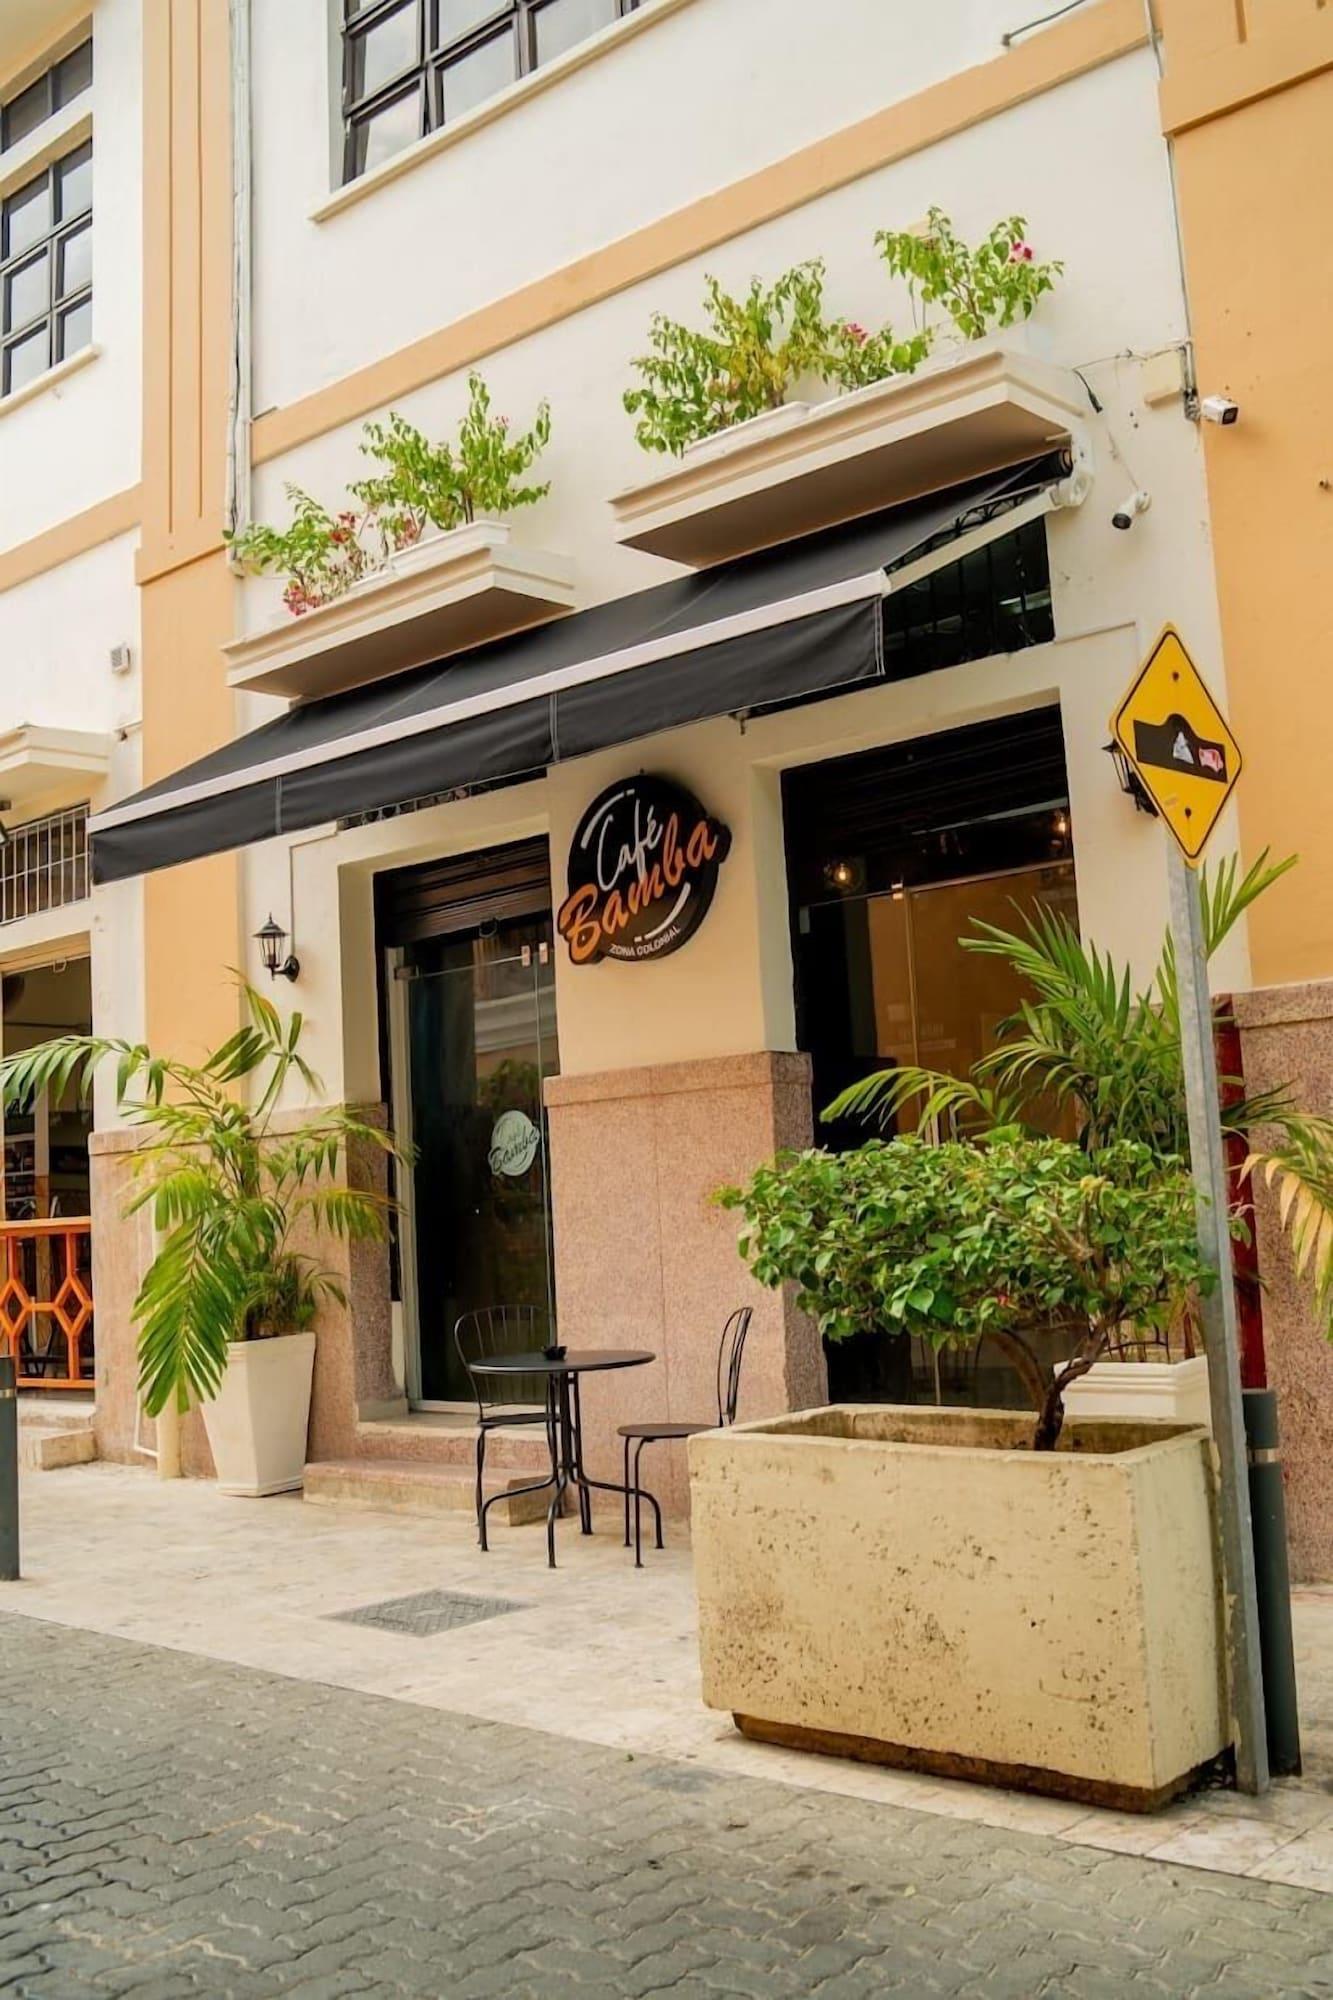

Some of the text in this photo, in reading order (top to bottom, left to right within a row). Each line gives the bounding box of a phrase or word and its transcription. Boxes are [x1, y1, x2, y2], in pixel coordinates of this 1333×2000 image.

[559, 812, 719, 961] Bamba
[597, 799, 664, 891] Café
[610, 925, 681, 957] ZONA COLONIAL
